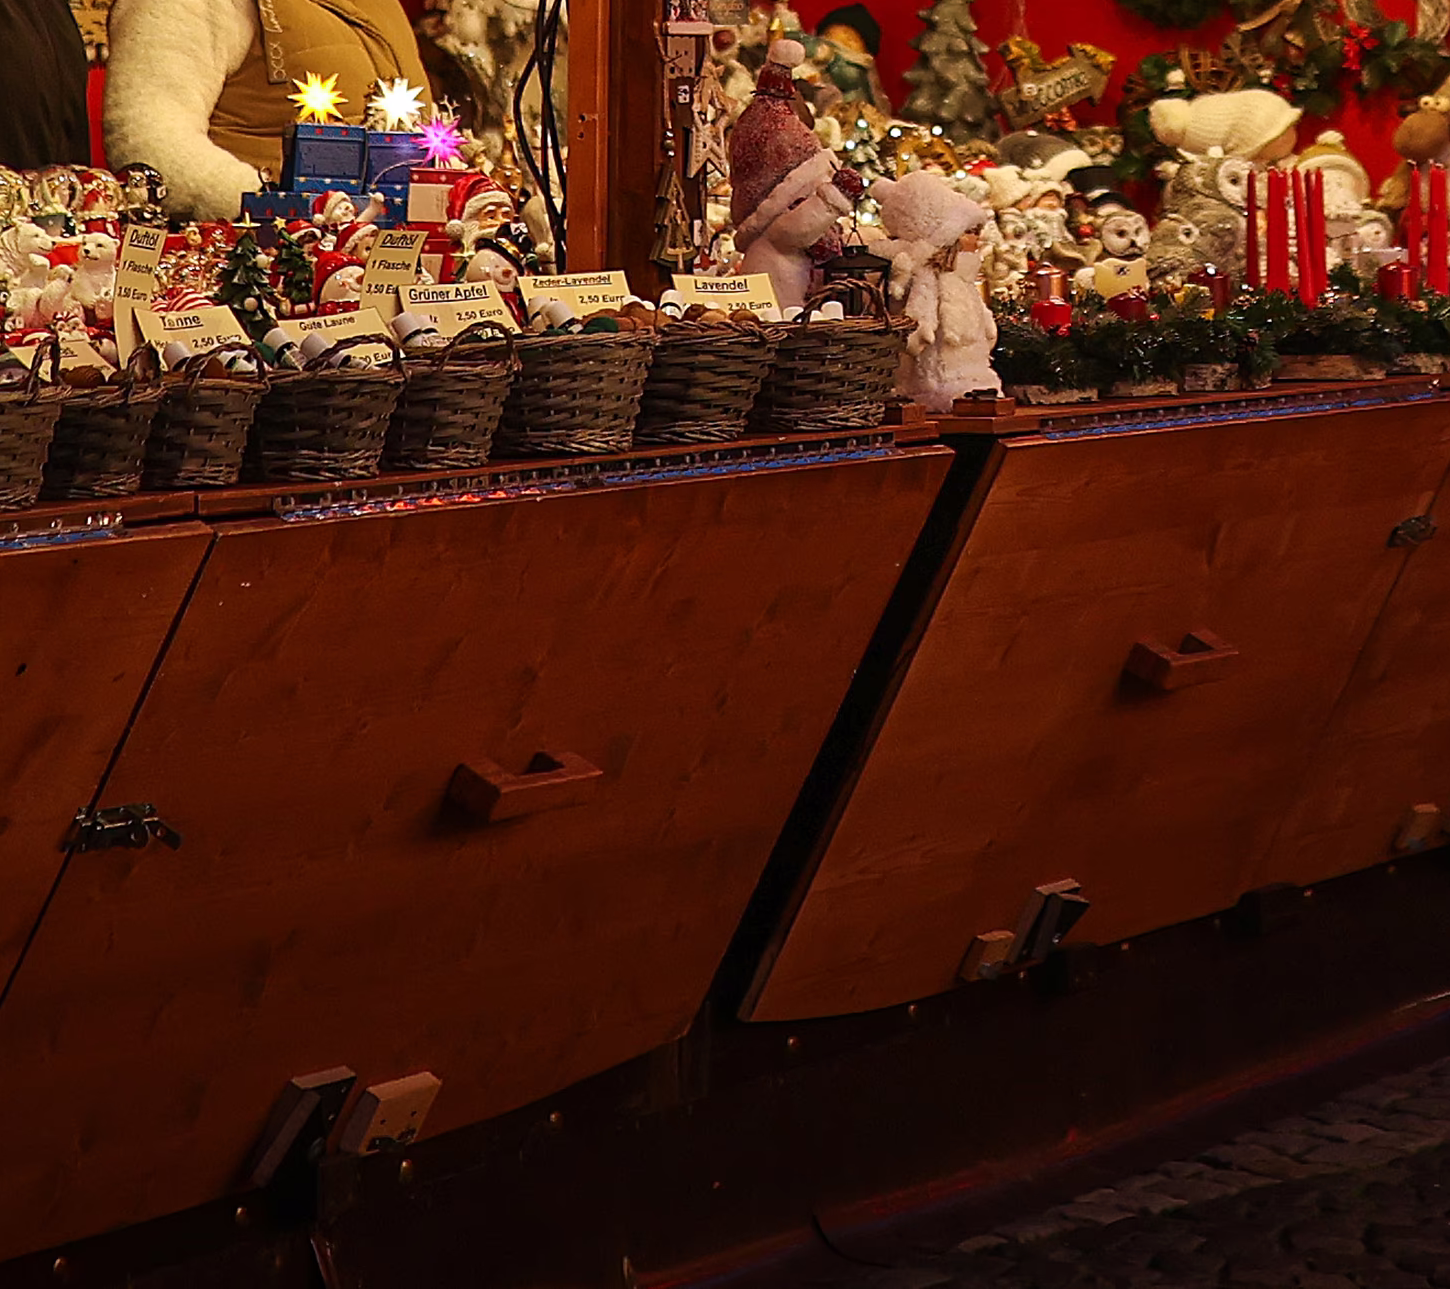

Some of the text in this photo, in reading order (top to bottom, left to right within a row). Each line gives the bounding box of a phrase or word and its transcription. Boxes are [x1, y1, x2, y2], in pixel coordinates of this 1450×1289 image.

[130, 229, 160, 247] Duftöl
[381, 234, 419, 246] Duftöl
[127, 260, 153, 273] Flasche
[377, 260, 411, 271] Flasche
[532, 274, 611, 287] Zeder-Lavendel
[694, 278, 748, 290] Lavendel
[131, 289, 148, 301] Euro
[366, 284, 399, 295] 3,50 Eu
[408, 285, 488, 301] Grüner Apfel
[579, 295, 599, 304] 2,50
[750, 301, 772, 310] Euro
[159, 314, 201, 327] Tanne
[456, 311, 477, 322] 2,50
[479, 309, 503, 318] Euro
[299, 316, 355, 331] Gute Laune
[192, 337, 214, 349] 2,50
[373, 351, 393, 361] Eur
